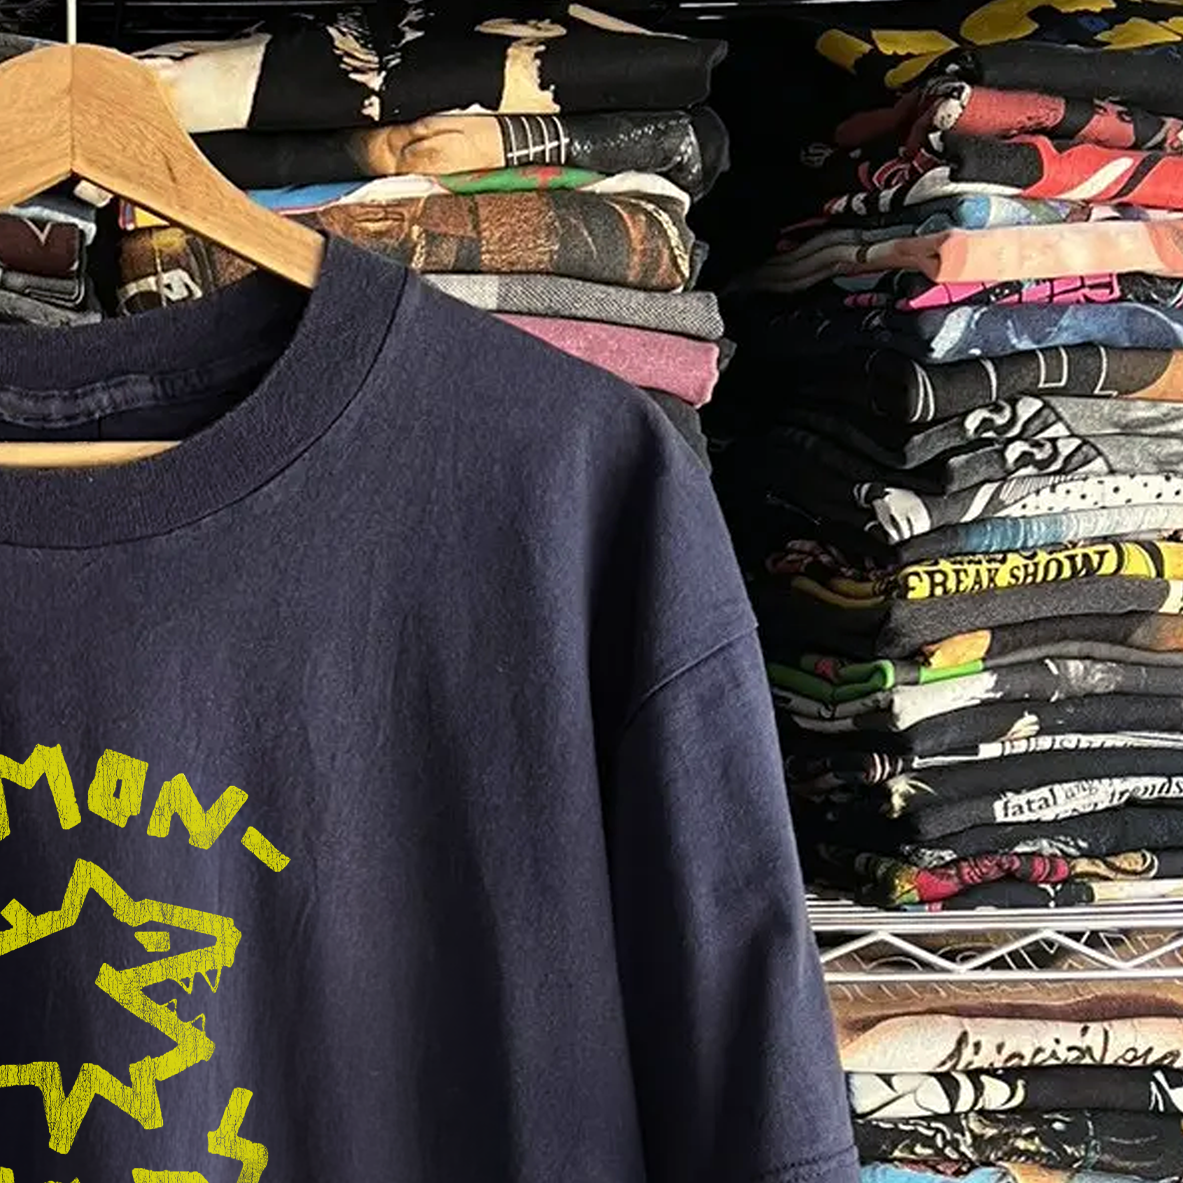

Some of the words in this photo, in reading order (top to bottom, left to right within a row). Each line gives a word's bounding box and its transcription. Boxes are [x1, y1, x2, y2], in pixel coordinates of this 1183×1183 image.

[903, 567, 1001, 600] FREAK
[1007, 550, 1111, 588] SHOW
[1002, 787, 1059, 818] fatal
